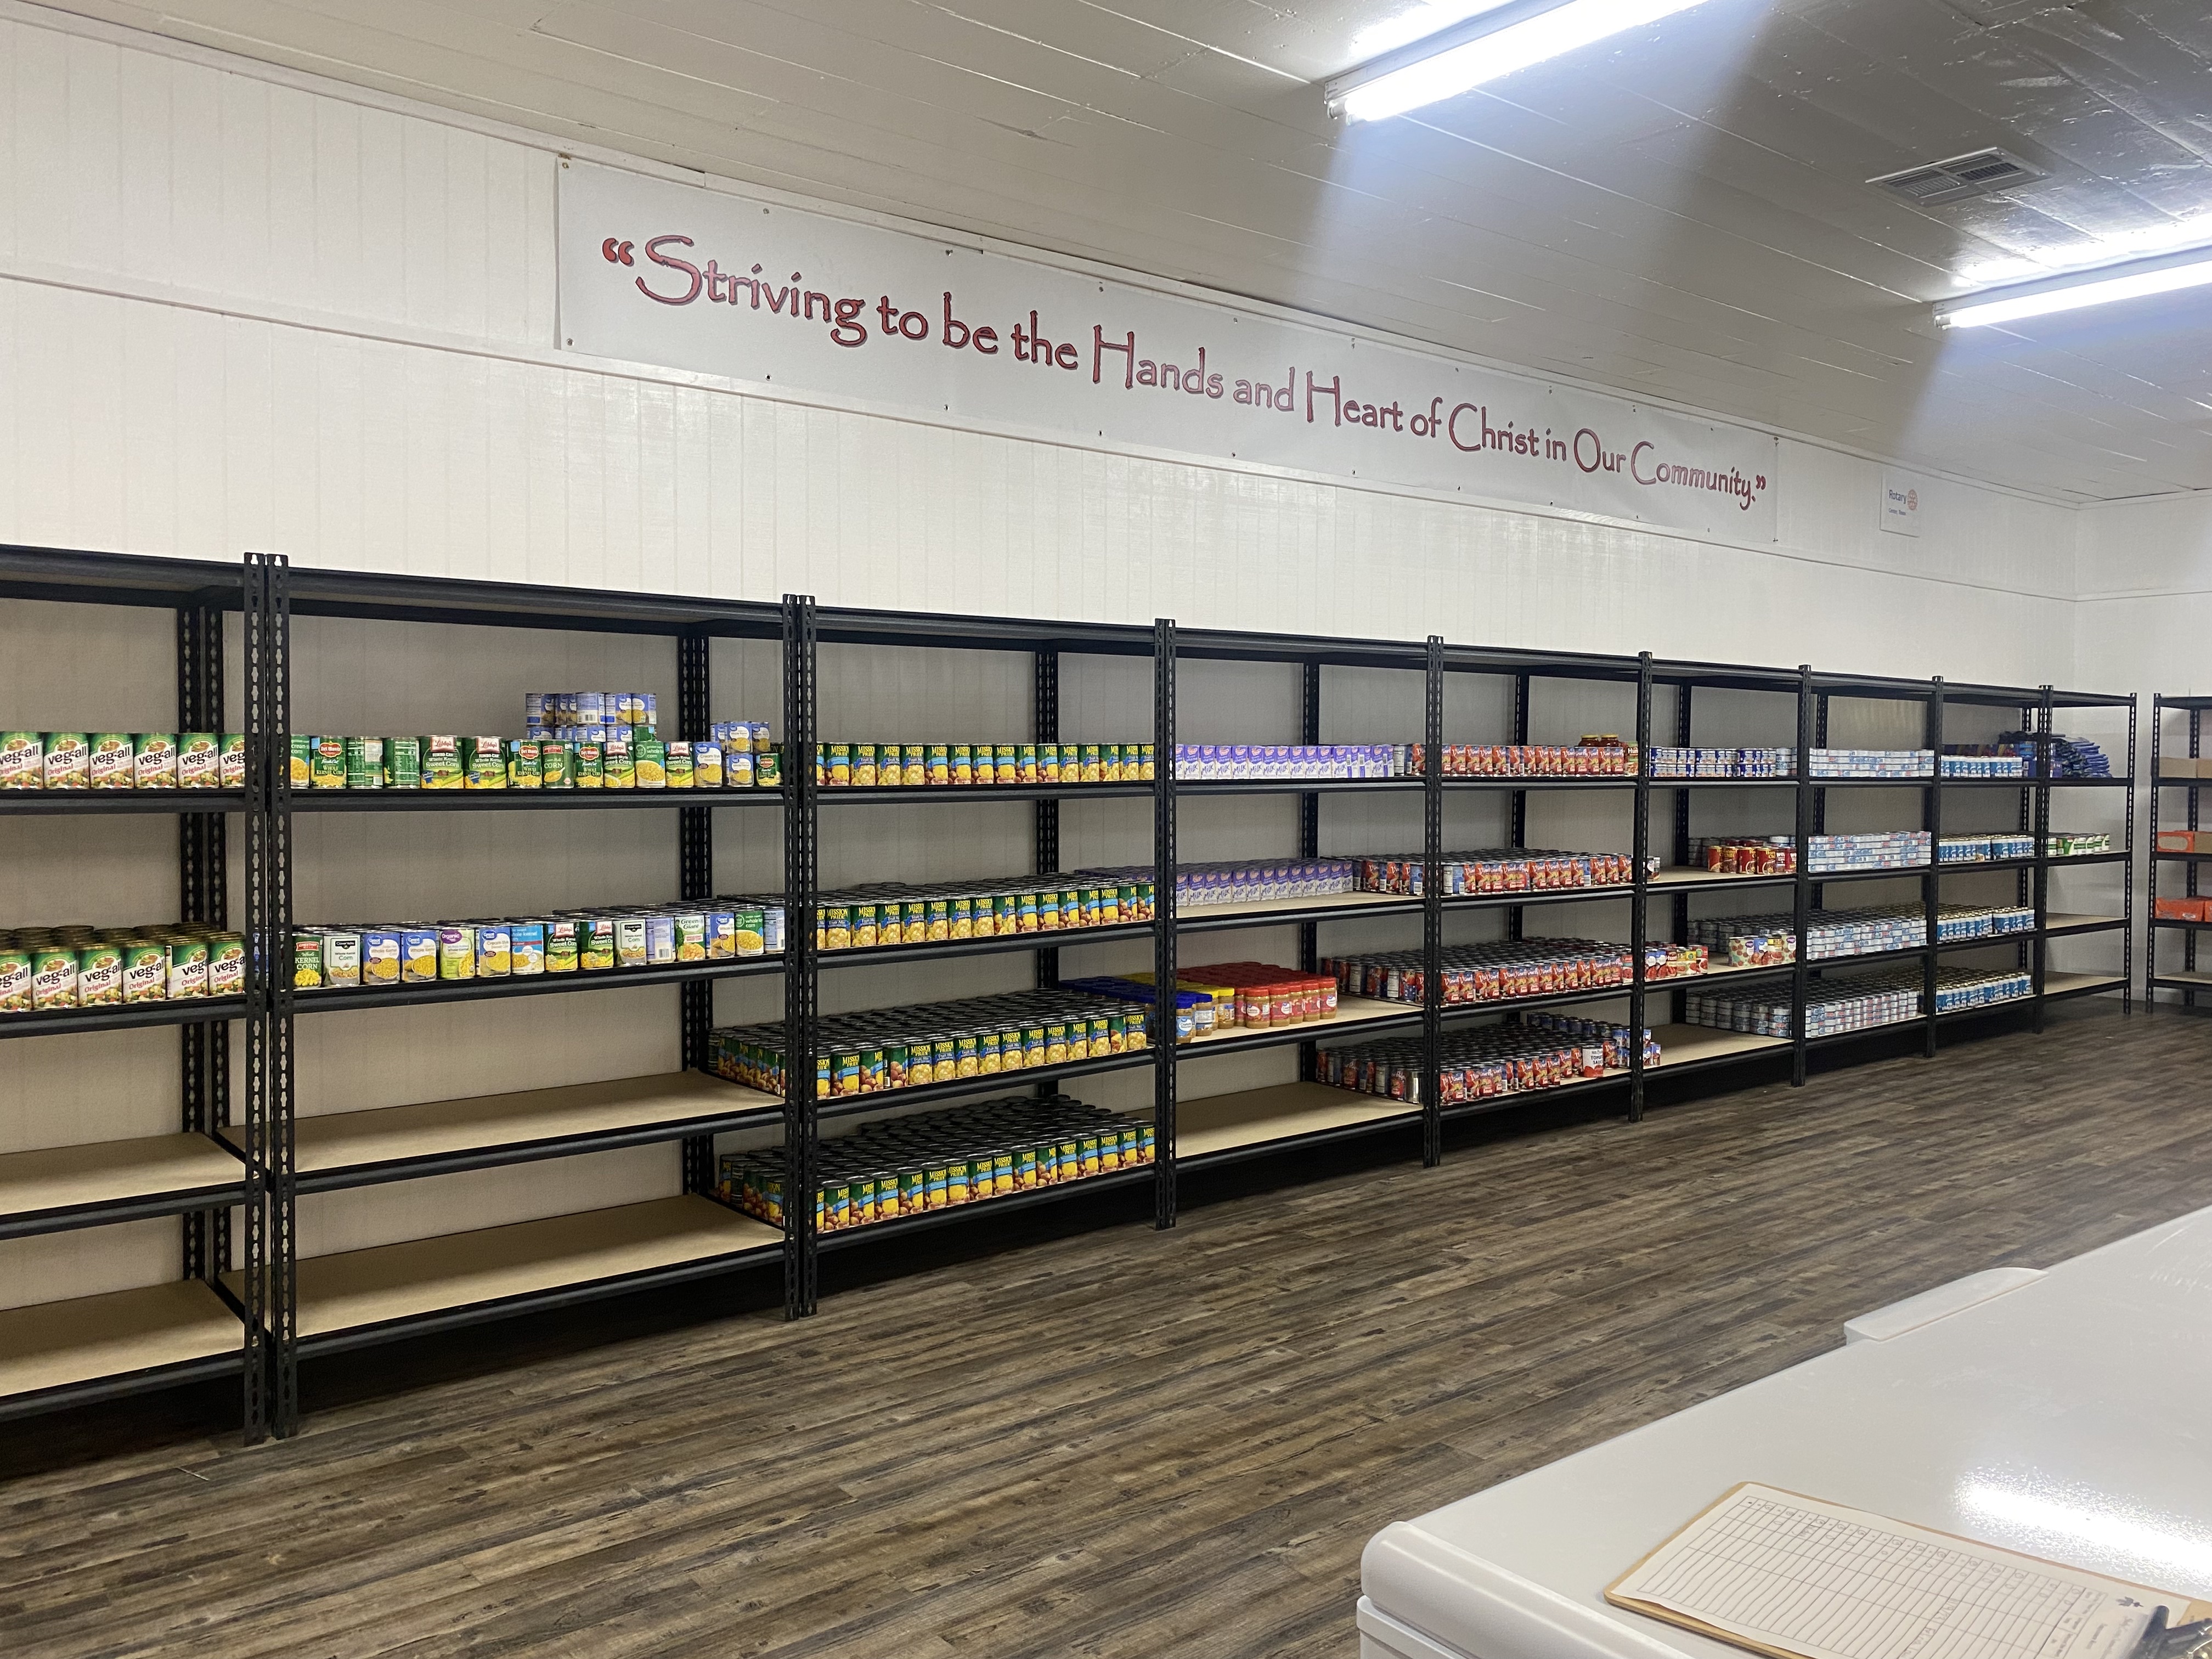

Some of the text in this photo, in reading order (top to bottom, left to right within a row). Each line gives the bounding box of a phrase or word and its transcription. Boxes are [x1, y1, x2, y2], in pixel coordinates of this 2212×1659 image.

[877, 295, 929, 340] to
[942, 291, 999, 354] be
[1011, 309, 1079, 371] the
[1092, 324, 1224, 399] Hands
[1233, 366, 1295, 413] and
[1306, 370, 1403, 432] Heart
[1409, 396, 1443, 439] of
[1448, 402, 1539, 457] Christ
[1544, 428, 1567, 462] in
[1573, 427, 1626, 475] Our
[1889, 489, 1906, 504] Rotary
[48, 746, 87, 765] veg-all
[92, 746, 130, 765] veg-all
[138, 746, 175, 765] veg-all
[182, 746, 217, 765] veg-all
[0, 764, 22, 774] riginal
[48, 764, 73, 775] Original
[92, 764, 116, 776] Original
[138, 764, 163, 776] Original
[182, 764, 206, 776] Original
[223, 765, 245, 775] Origin
[827, 909, 848, 917] MISSION
[214, 956, 245, 973] veg-a
[36, 964, 75, 985] veg-all
[214, 972, 238, 983] Original
[84, 980, 110, 992] Original
[129, 977, 154, 990] Original
[36, 984, 61, 996] Original
